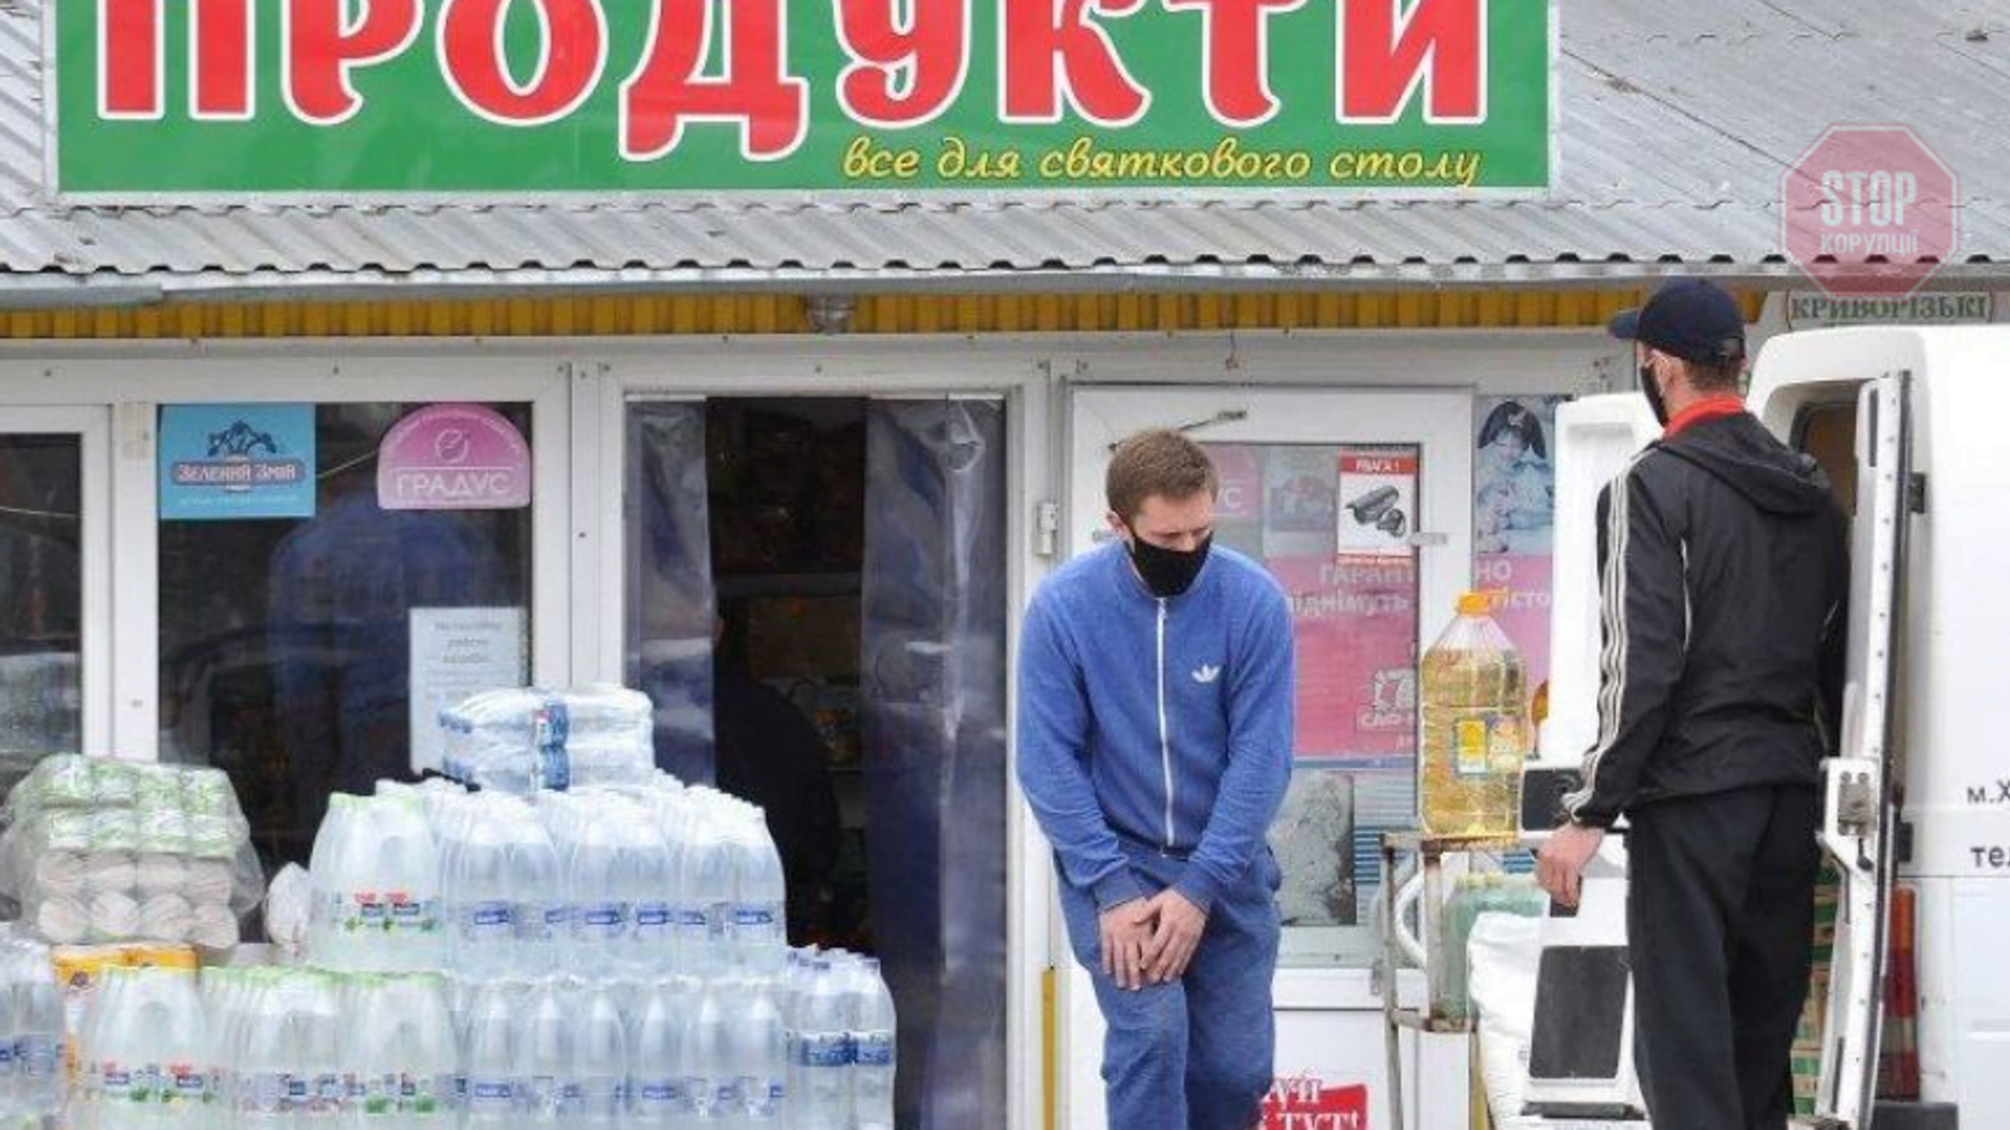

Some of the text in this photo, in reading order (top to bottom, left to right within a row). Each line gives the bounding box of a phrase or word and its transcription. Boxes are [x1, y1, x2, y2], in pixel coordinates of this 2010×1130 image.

[97, 0, 1488, 161] ПРОДУКТИ
[842, 137, 1480, 187] все для святкового столу
[397, 471, 512, 498] ГРАДУС
[1970, 846, 2010, 868] те
